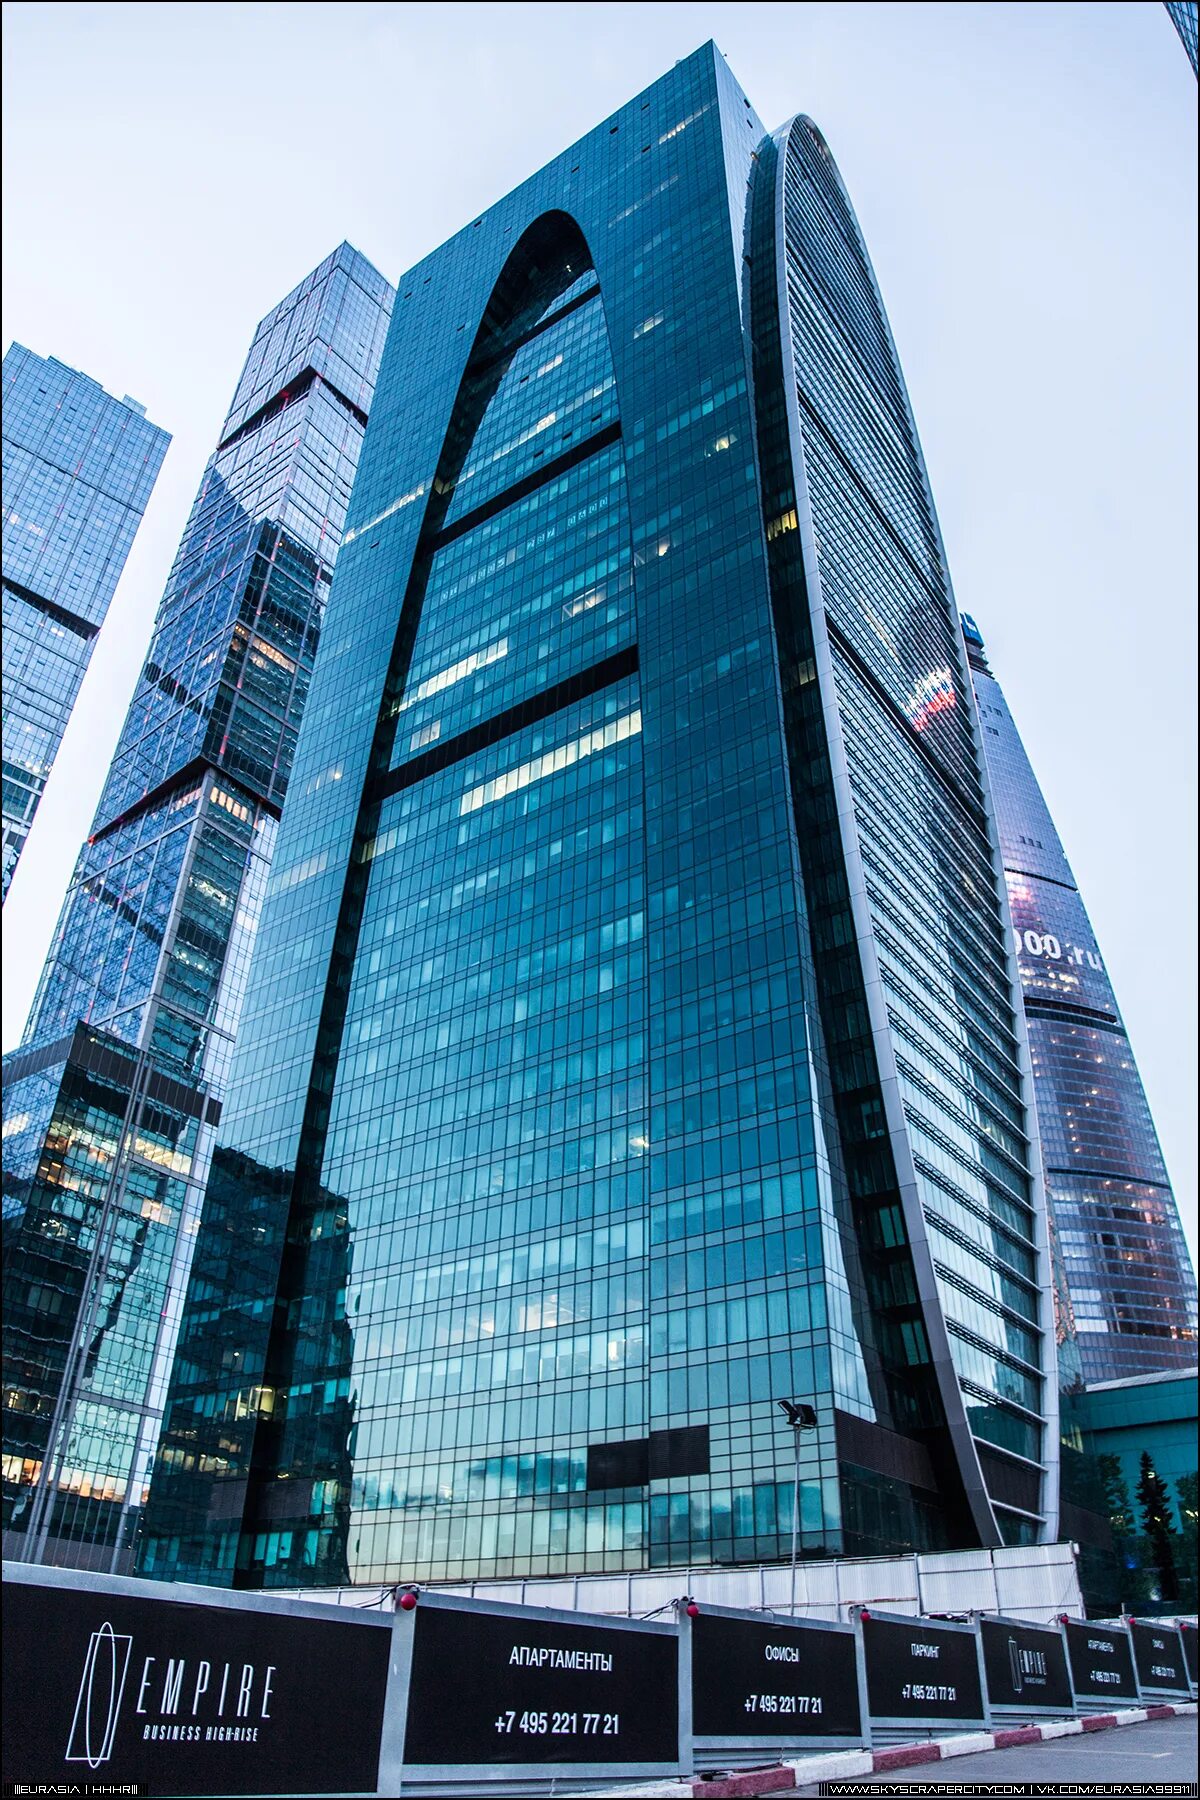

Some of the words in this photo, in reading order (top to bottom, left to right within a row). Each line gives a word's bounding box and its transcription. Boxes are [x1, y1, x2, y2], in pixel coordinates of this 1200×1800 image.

[508, 1645, 613, 1672] АПАРТАМЕНТЫ
[764, 1644, 800, 1664] ОФИСЫ
[910, 1643, 940, 1659] ПАРКИНГ
[135, 1656, 277, 1719] EMPIRE
[901, 1684, 911, 1699] +7
[911, 1684, 925, 1700] 495
[925, 1685, 938, 1700] 221
[938, 1686, 947, 1700] 77
[947, 1686, 956, 1701] 21
[744, 1694, 758, 1712] +7
[759, 1694, 778, 1713] 495
[778, 1695, 796, 1713] 221
[797, 1696, 810, 1713] 77
[810, 1697, 822, 1714] 21
[494, 1710, 516, 1733] +7
[519, 1711, 548, 1734] 495
[551, 1711, 577, 1734] 221
[582, 1713, 601, 1734] 77
[603, 1713, 619, 1735] 21
[142, 1724, 202, 1741] BUSINESS
[205, 1726, 259, 1742] HIGH-RISE
